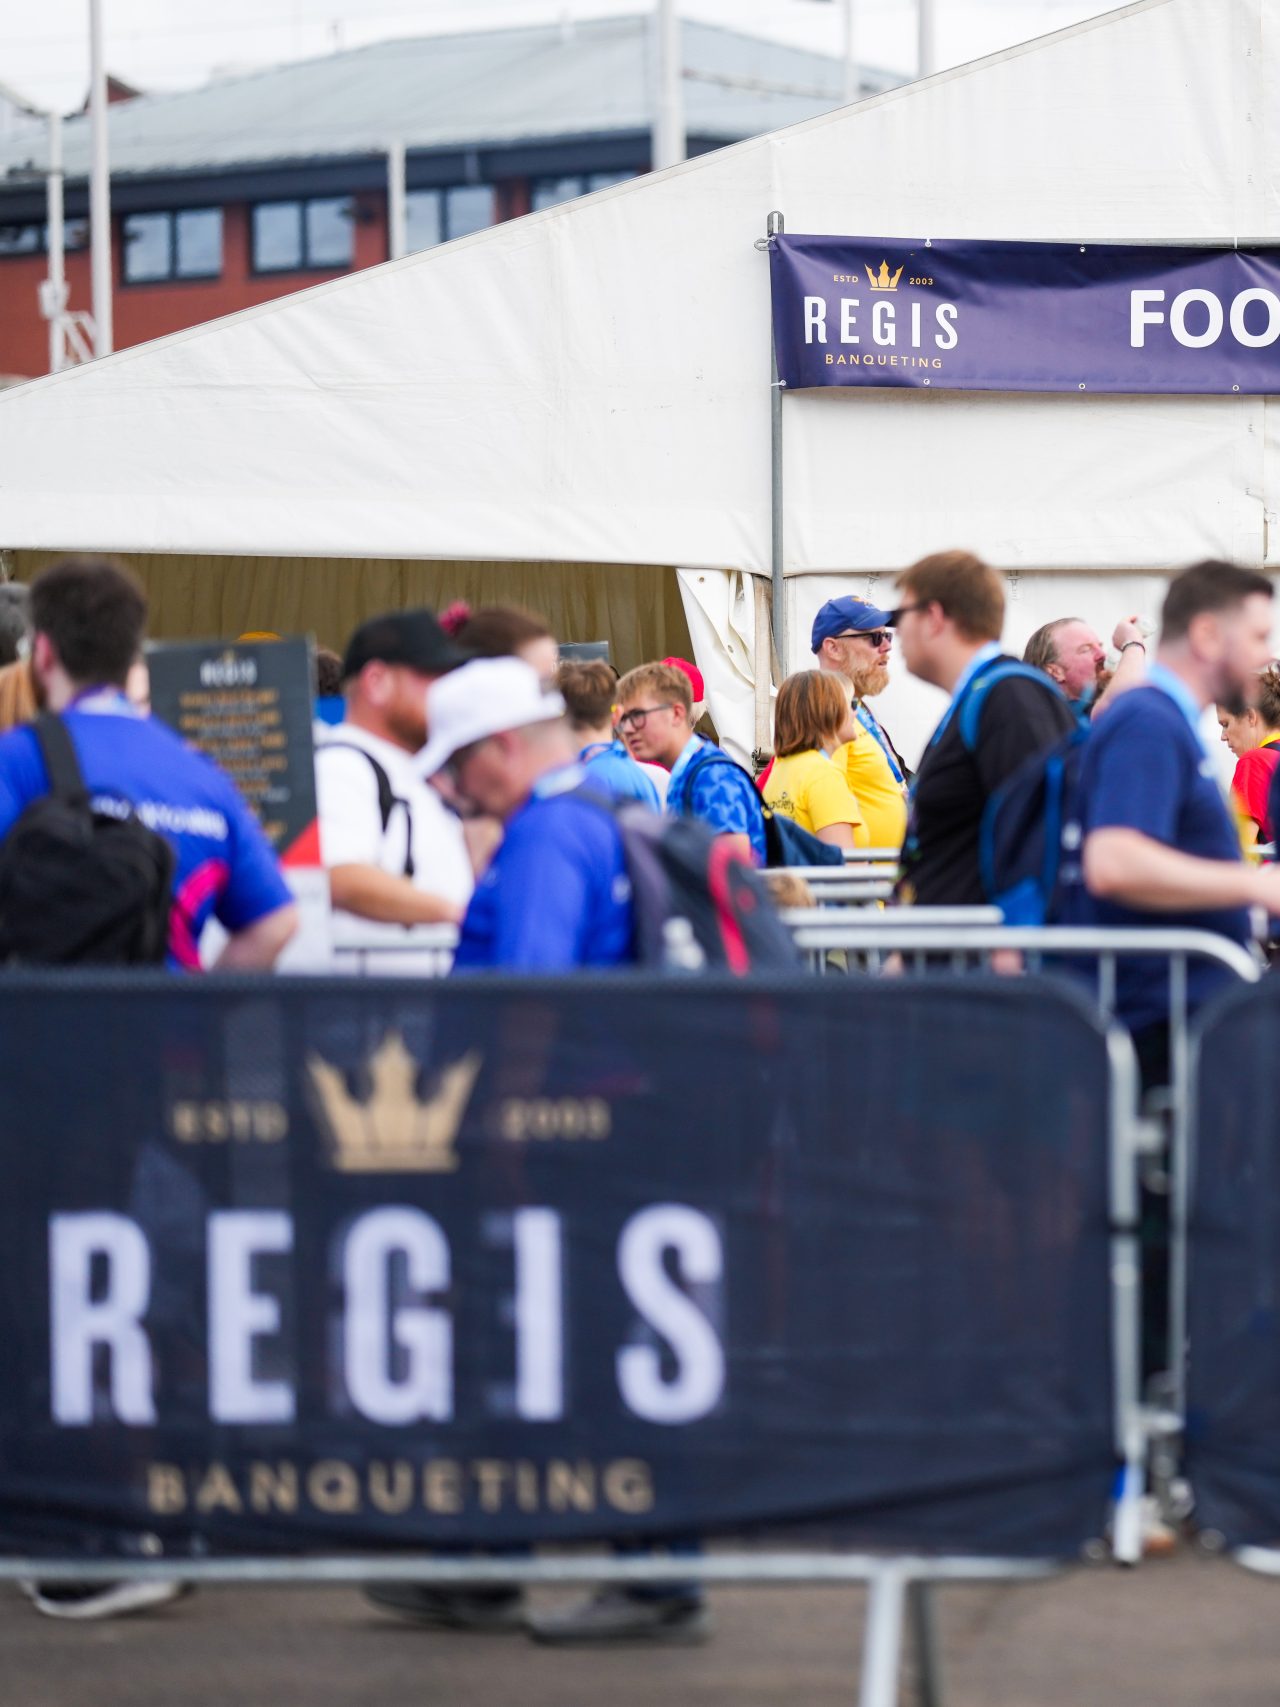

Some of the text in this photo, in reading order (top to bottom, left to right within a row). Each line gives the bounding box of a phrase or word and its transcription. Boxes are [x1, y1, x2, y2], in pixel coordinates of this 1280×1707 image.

[833, 275, 933, 286] ESTD 2003
[804, 296, 959, 349] REGIS
[825, 353, 942, 369] BANQUETING
[172, 1100, 289, 1144] ESTD
[49, 1203, 726, 1426] REGIS
[147, 1459, 655, 1514] BANQUETING
